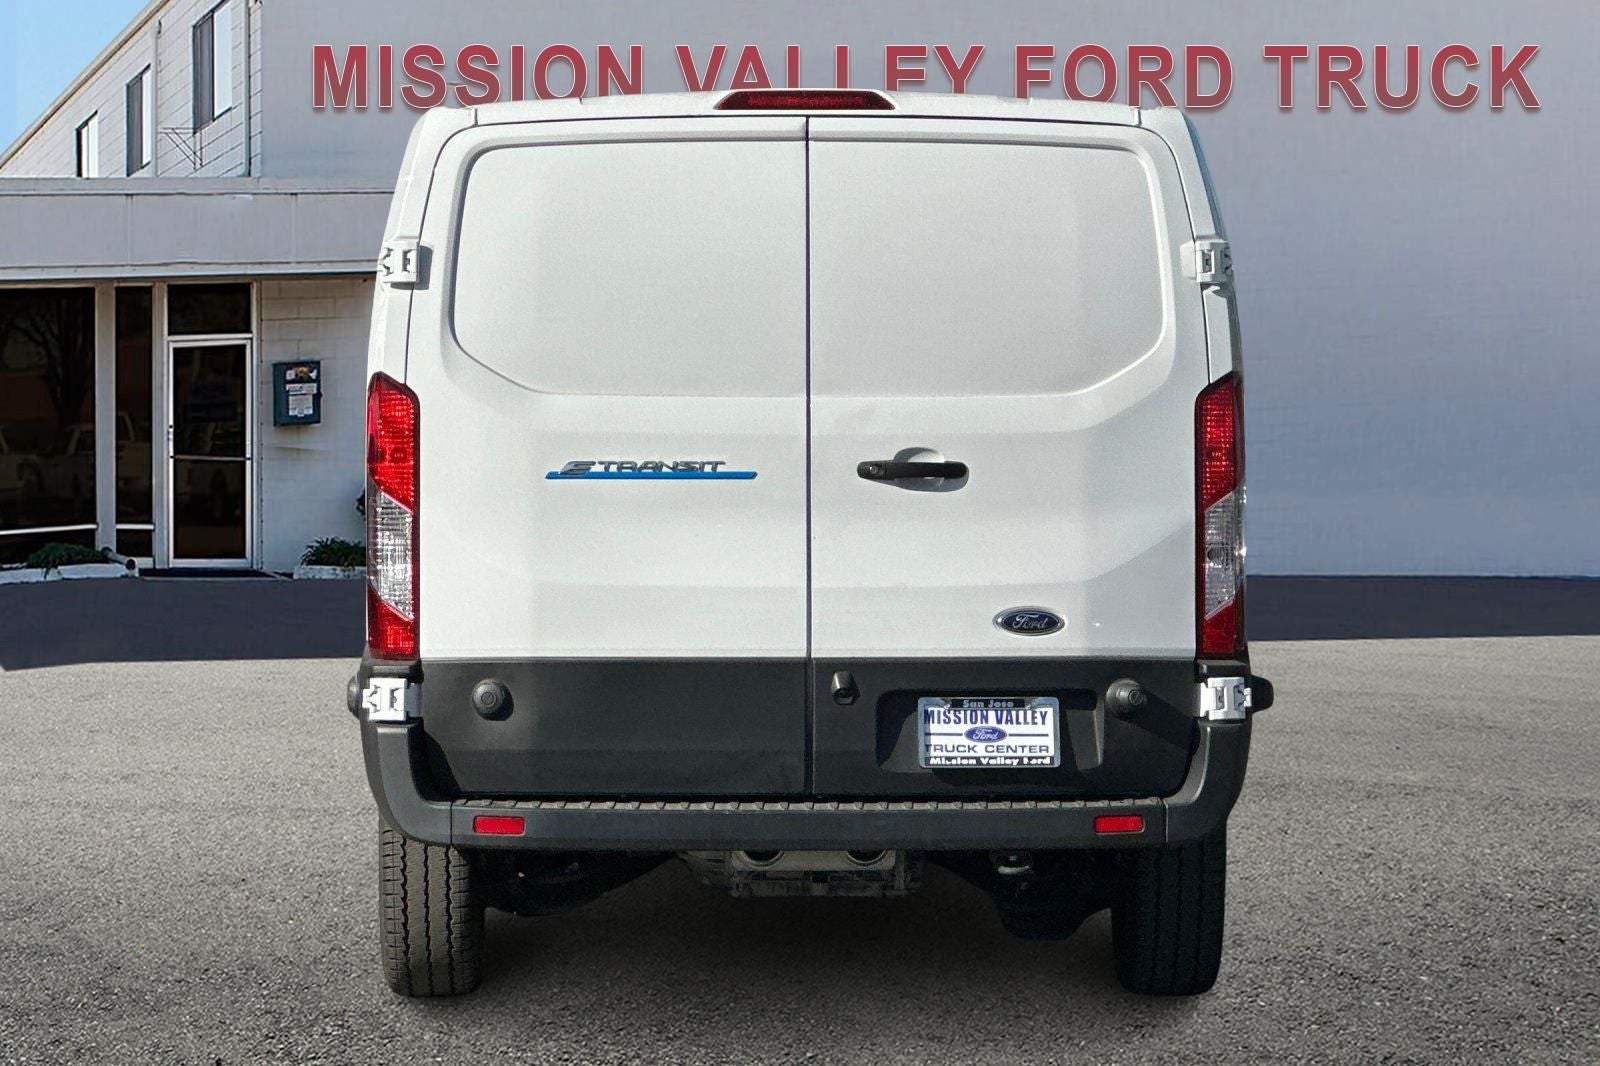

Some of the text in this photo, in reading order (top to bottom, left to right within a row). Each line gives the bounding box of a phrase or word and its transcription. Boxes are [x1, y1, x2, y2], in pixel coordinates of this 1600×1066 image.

[312, 43, 1542, 109] MISSION VALLEY FORD TRUCK
[962, 699, 1014, 708] San Jose
[923, 709, 1048, 725] MISSION VALLEY
[925, 744, 1050, 754] TRUCK CENTER
[929, 757, 977, 765] Mission
[980, 757, 1020, 766] Valley
